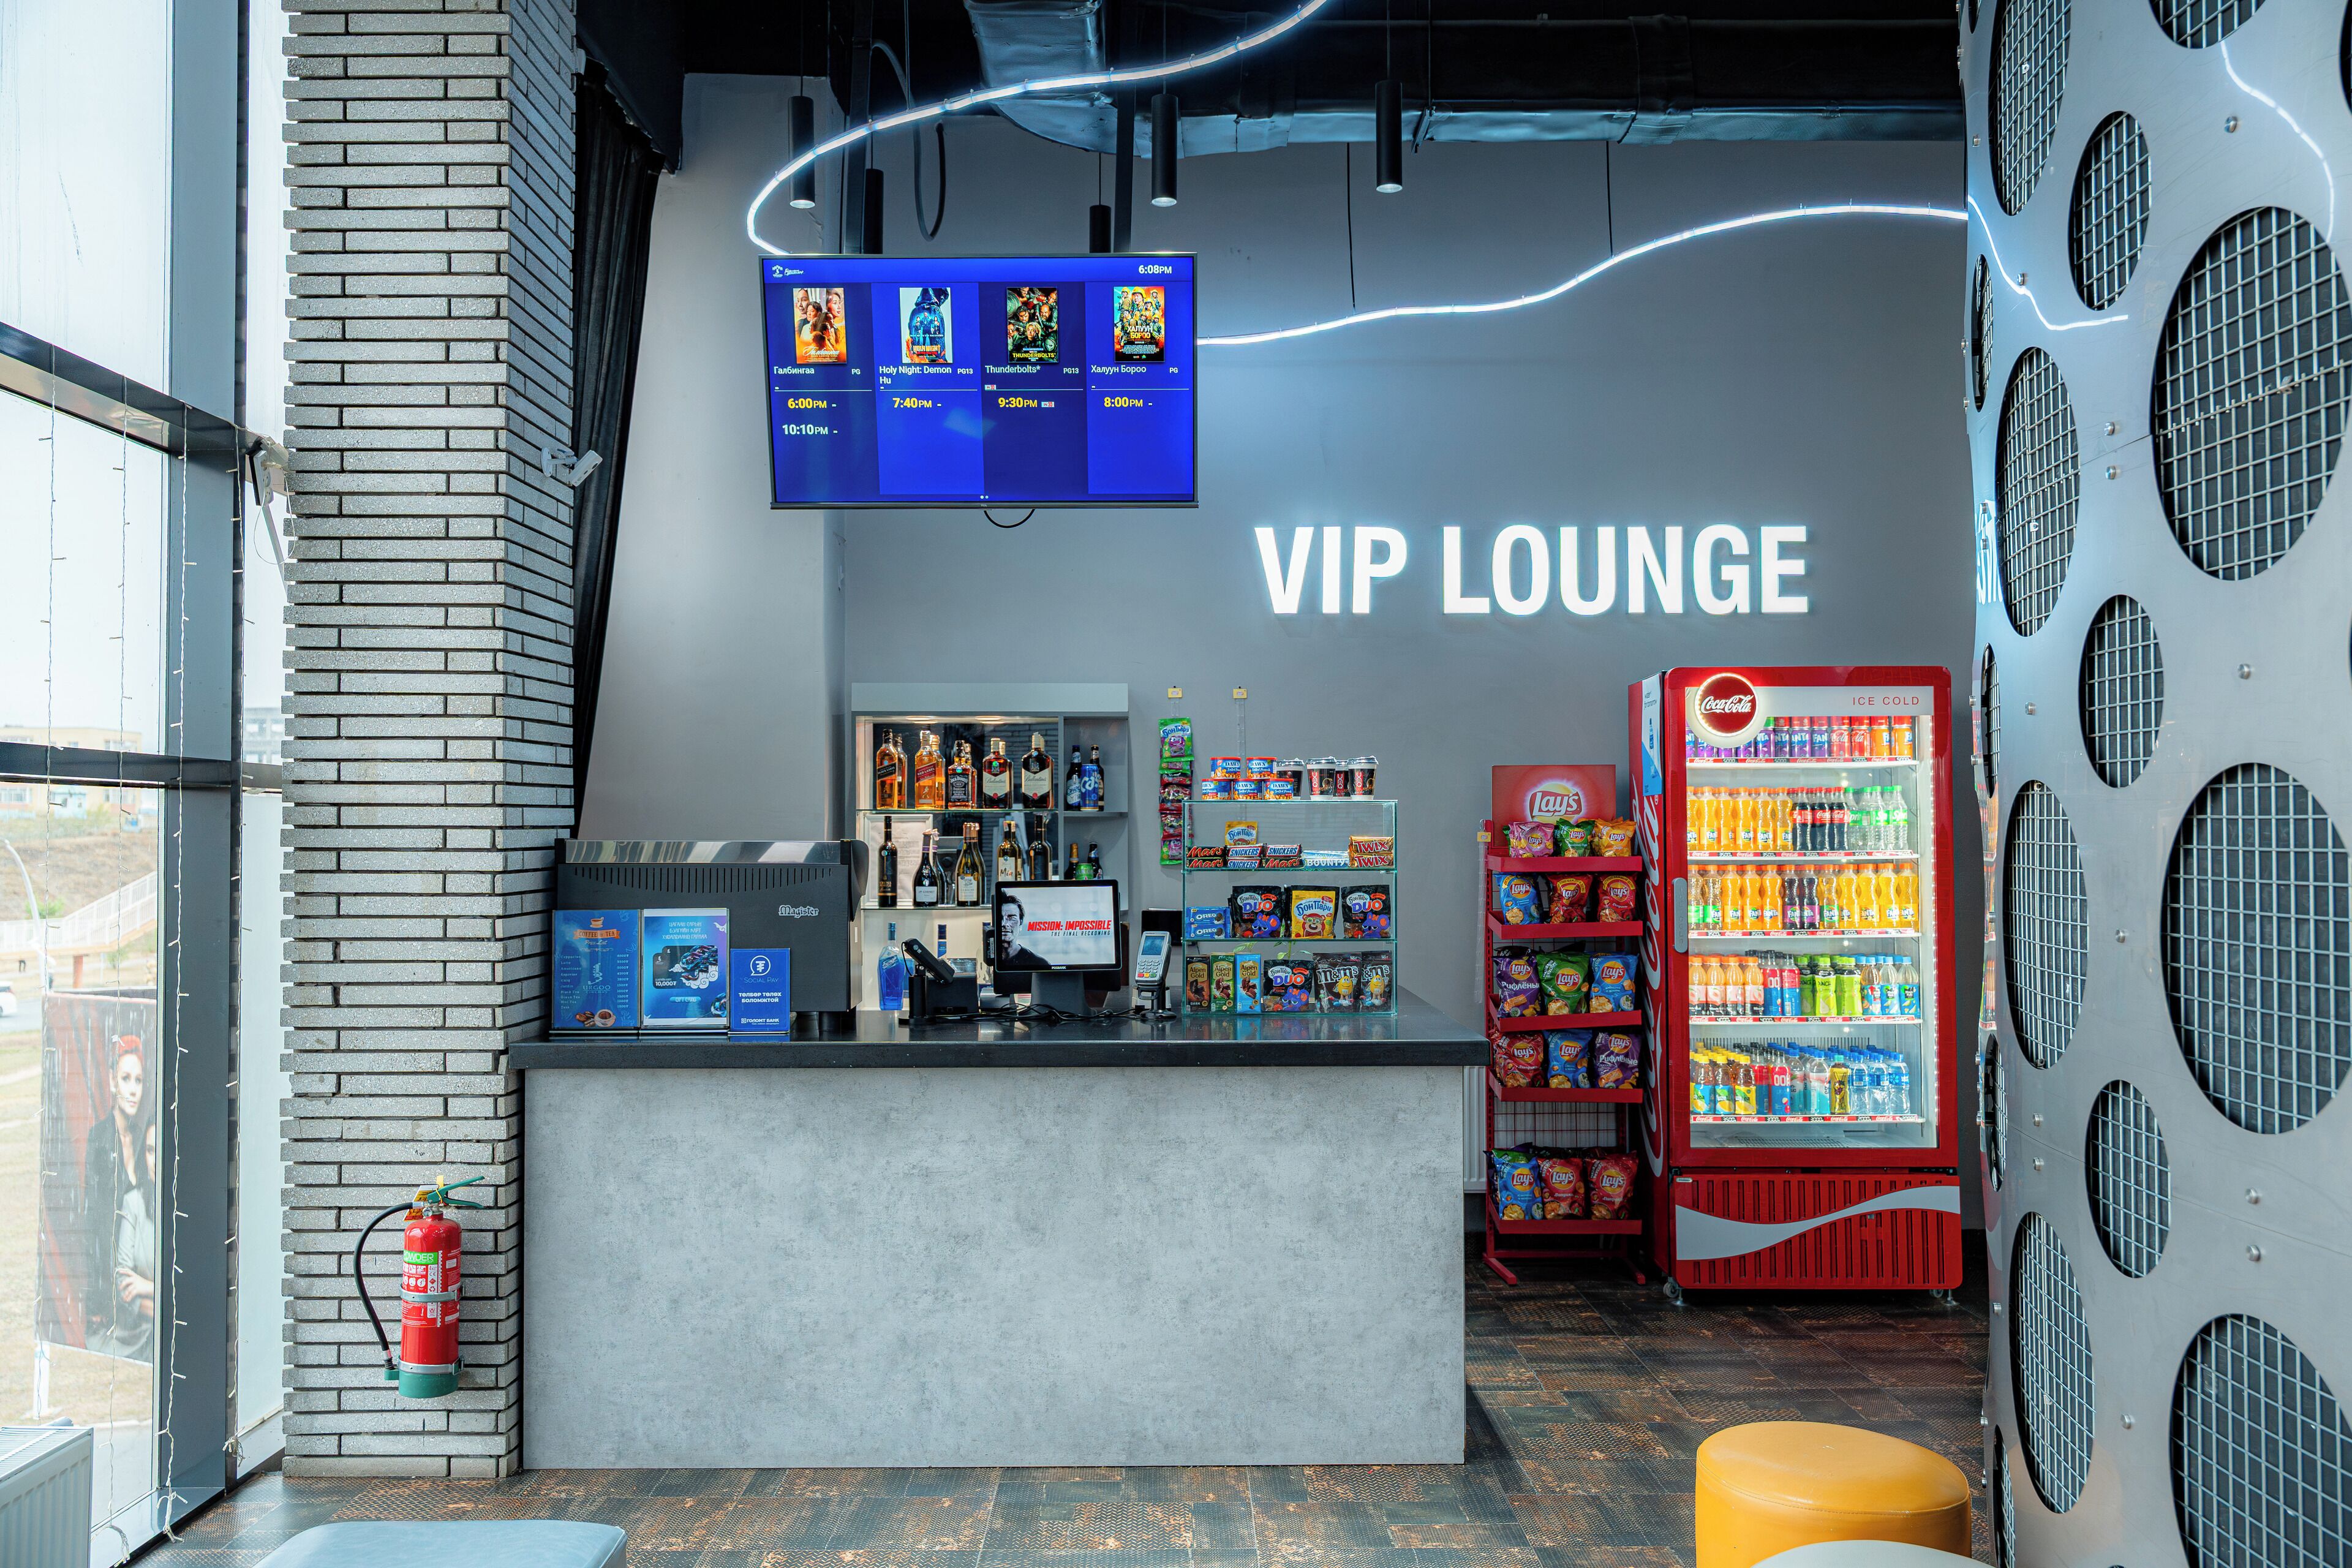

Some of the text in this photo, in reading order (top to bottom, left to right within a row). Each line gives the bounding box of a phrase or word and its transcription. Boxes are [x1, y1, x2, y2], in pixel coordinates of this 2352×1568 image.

[1139, 265, 1172, 274] 6:08PM
[879, 366, 897, 375] Holy
[899, 366, 922, 375] Night:
[1091, 365, 1147, 374] Халуун Бороо
[788, 398, 827, 409] 6:00PM
[892, 398, 932, 408] 7:40PM
[998, 398, 1038, 407] 9:30PM
[1104, 397, 1143, 407] 8:00PM
[782, 424, 828, 435] 10:10PM
[1254, 524, 1809, 616] VIP LOUNGE
[1701, 695, 1754, 714] Coca-Cola
[1853, 696, 1920, 706] ICE COLD
[1532, 791, 1580, 817] Lay's
[1570, 830, 1585, 839] Lay's
[1610, 832, 1626, 842] Lay's
[1528, 836, 1543, 845] Lay's
[1186, 846, 1224, 858] Mars
[1230, 848, 1260, 856] SNICKERS
[1268, 846, 1298, 855] SNICKERS
[1354, 840, 1389, 853] Twix
[1189, 859, 1224, 868] Mars
[1228, 860, 1257, 869] SNICKERS
[1265, 858, 1300, 868] Mars
[1355, 854, 1389, 868] Twix
[1511, 883, 1530, 895] Lay's
[778, 905, 819, 918] Magister
[1242, 900, 1273, 913] DUO
[1351, 900, 1382, 913] DUO
[1027, 920, 1112, 932] MISSION: IMPOSSIBLE
[1510, 963, 1531, 976] Lay's
[1602, 967, 1624, 979] Lay's
[1273, 974, 1305, 986] DUO
[1501, 981, 1539, 990] Рифлёны
[1557, 974, 1578, 986] Lay's
[1610, 1036, 1630, 1048] Lay's
[1514, 1047, 1534, 1058] Lay's
[1561, 1046, 1581, 1058] Lay's
[1600, 1055, 1638, 1066] Рифлёные
[1513, 1174, 1534, 1186] Lay's
[1551, 1172, 1574, 1185] Lay's
[1602, 1175, 1624, 1188] Lay's
[404, 1251, 434, 1261] OWDER
